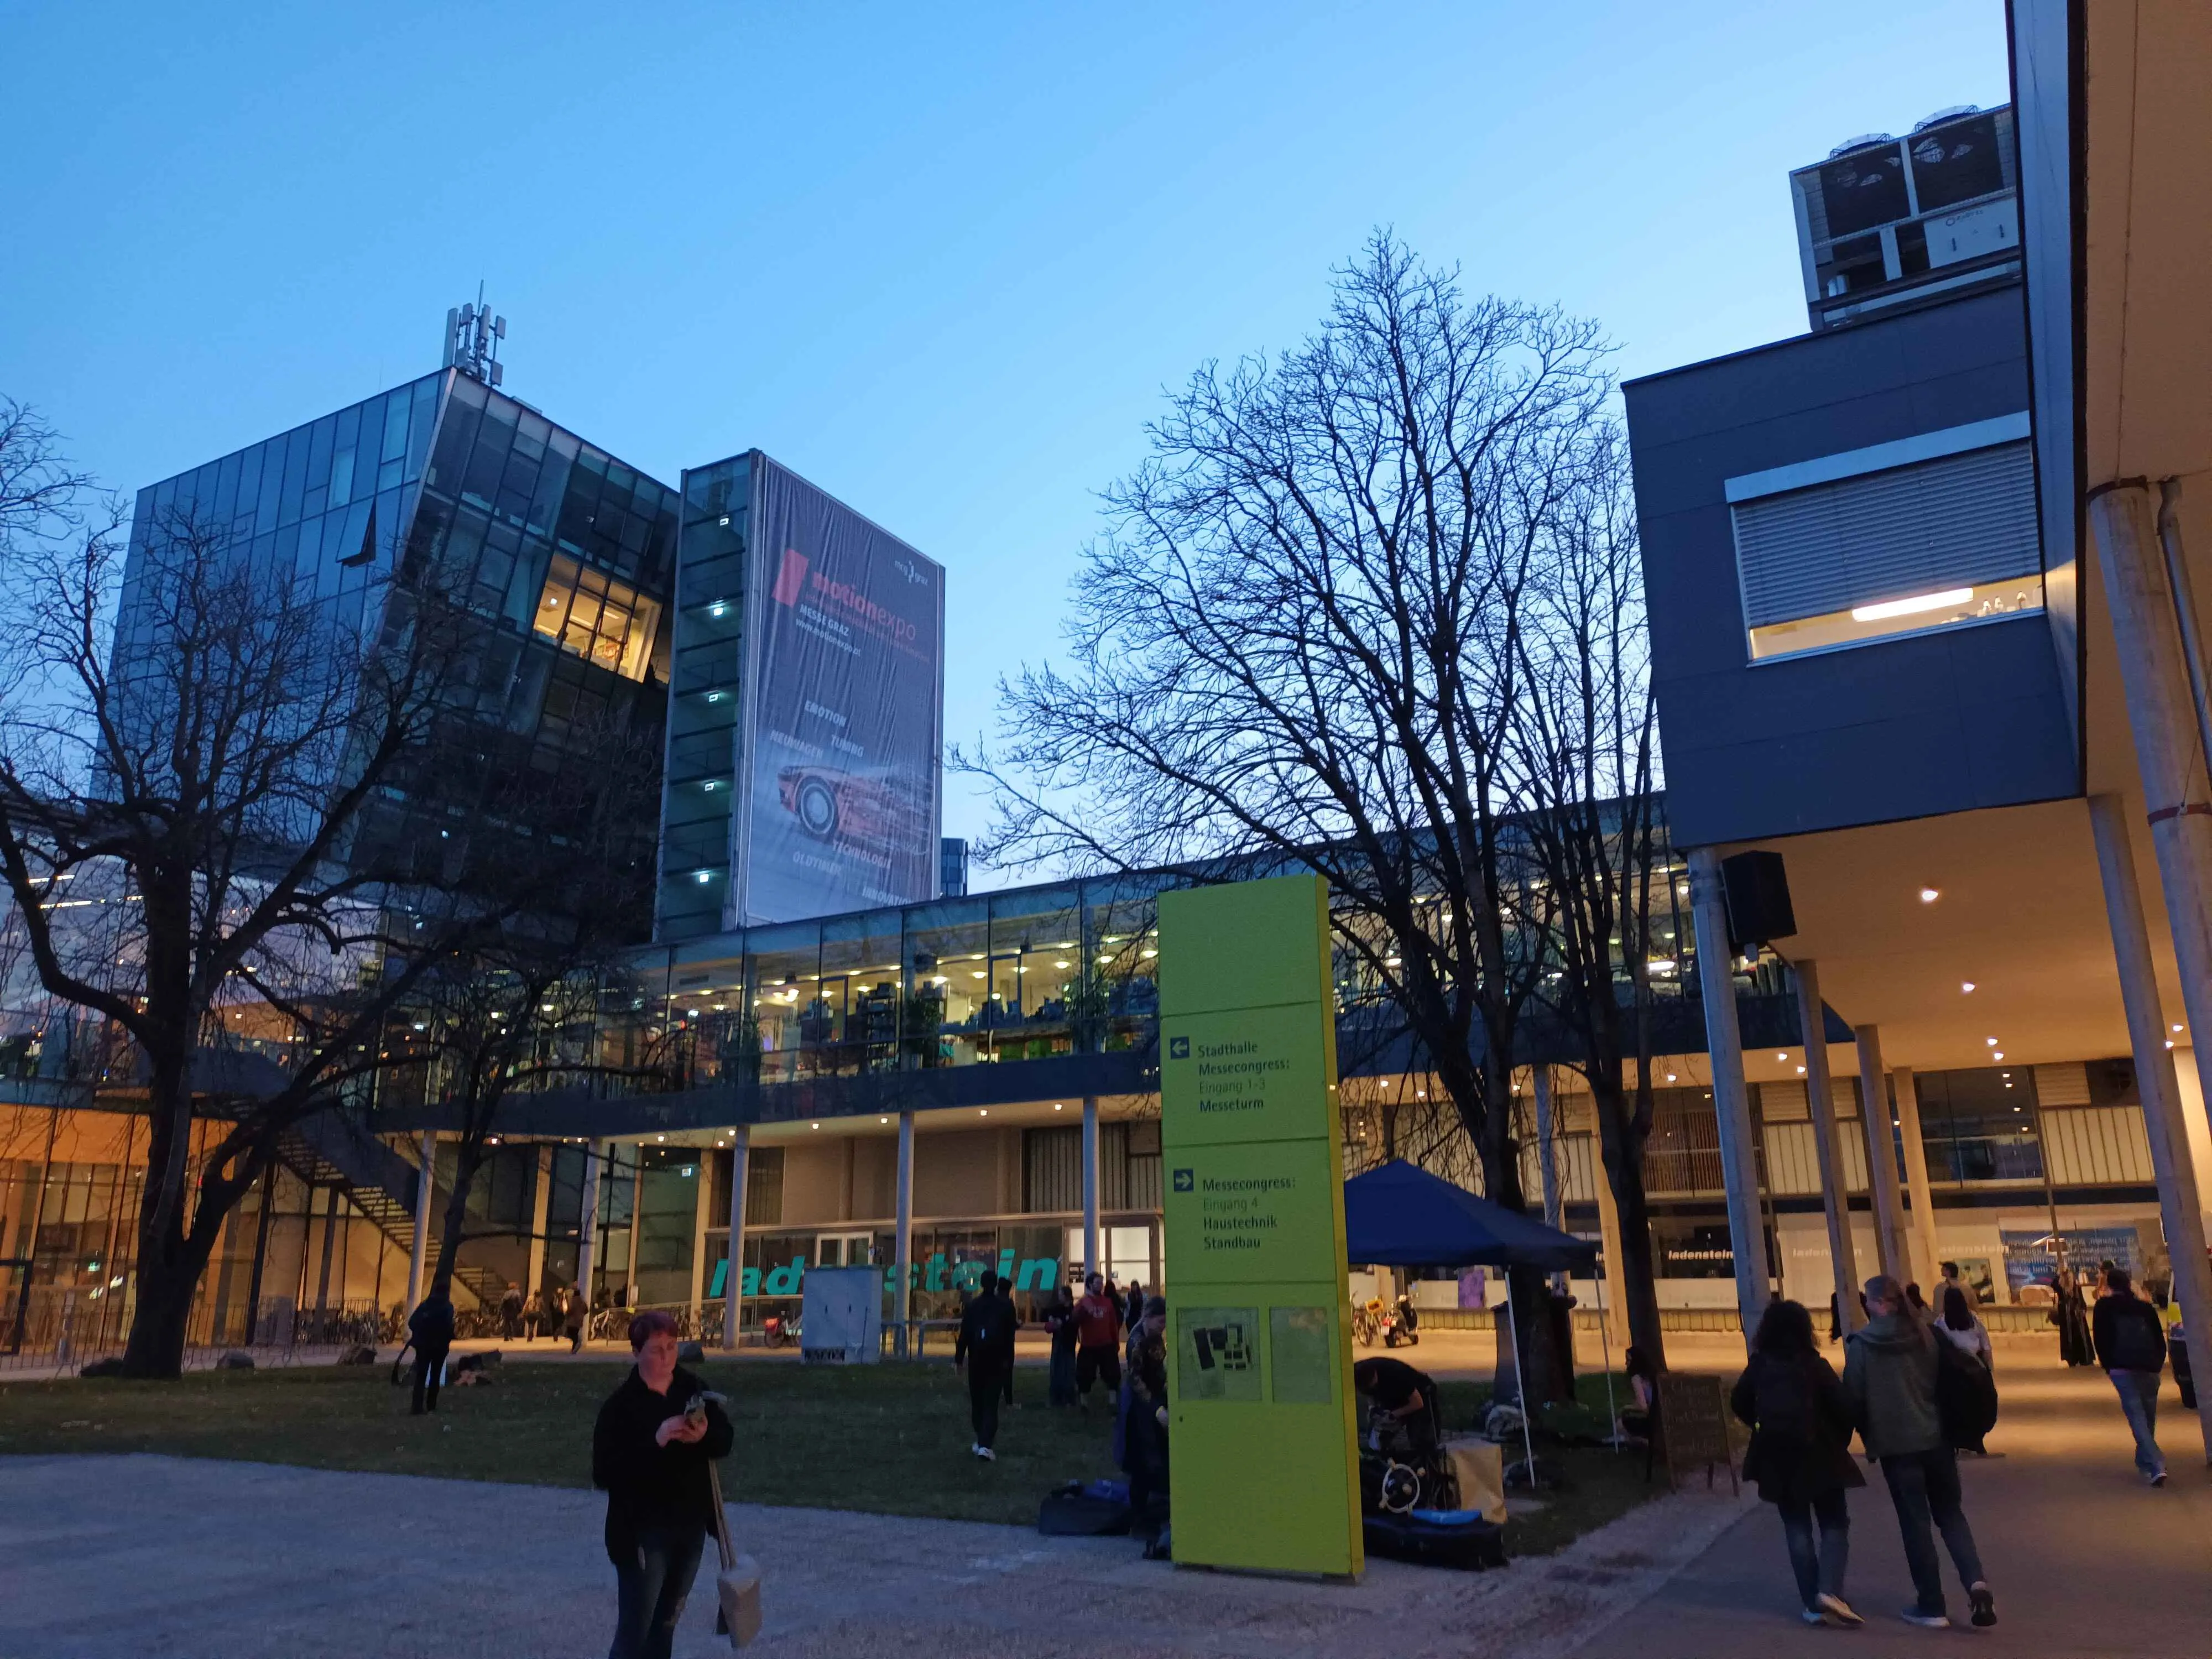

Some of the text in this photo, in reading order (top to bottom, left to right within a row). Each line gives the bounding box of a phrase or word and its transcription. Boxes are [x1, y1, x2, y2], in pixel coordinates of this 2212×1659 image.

[812, 572, 916, 640] motionexpo
[799, 604, 850, 637] MESSE GRAZ
[804, 699, 847, 727] EMOTION
[770, 729, 823, 759] NEUWAGEN
[831, 734, 864, 758] TUNING
[793, 851, 842, 874] OLDTIMER
[1198, 1041, 1258, 1058] Stadthalle
[1199, 1058, 1290, 1076] Messecongress:
[1199, 1080, 1266, 1094] Eingang 1-3
[1200, 1099, 1264, 1112] Messeturm
[1203, 1177, 1296, 1193] Messecongress:
[1203, 1198, 1259, 1212] Eingang 4
[1204, 1215, 1277, 1230] Haustechnik
[1204, 1237, 1261, 1250] Standbau
[709, 1248, 1058, 1298] ladstein
